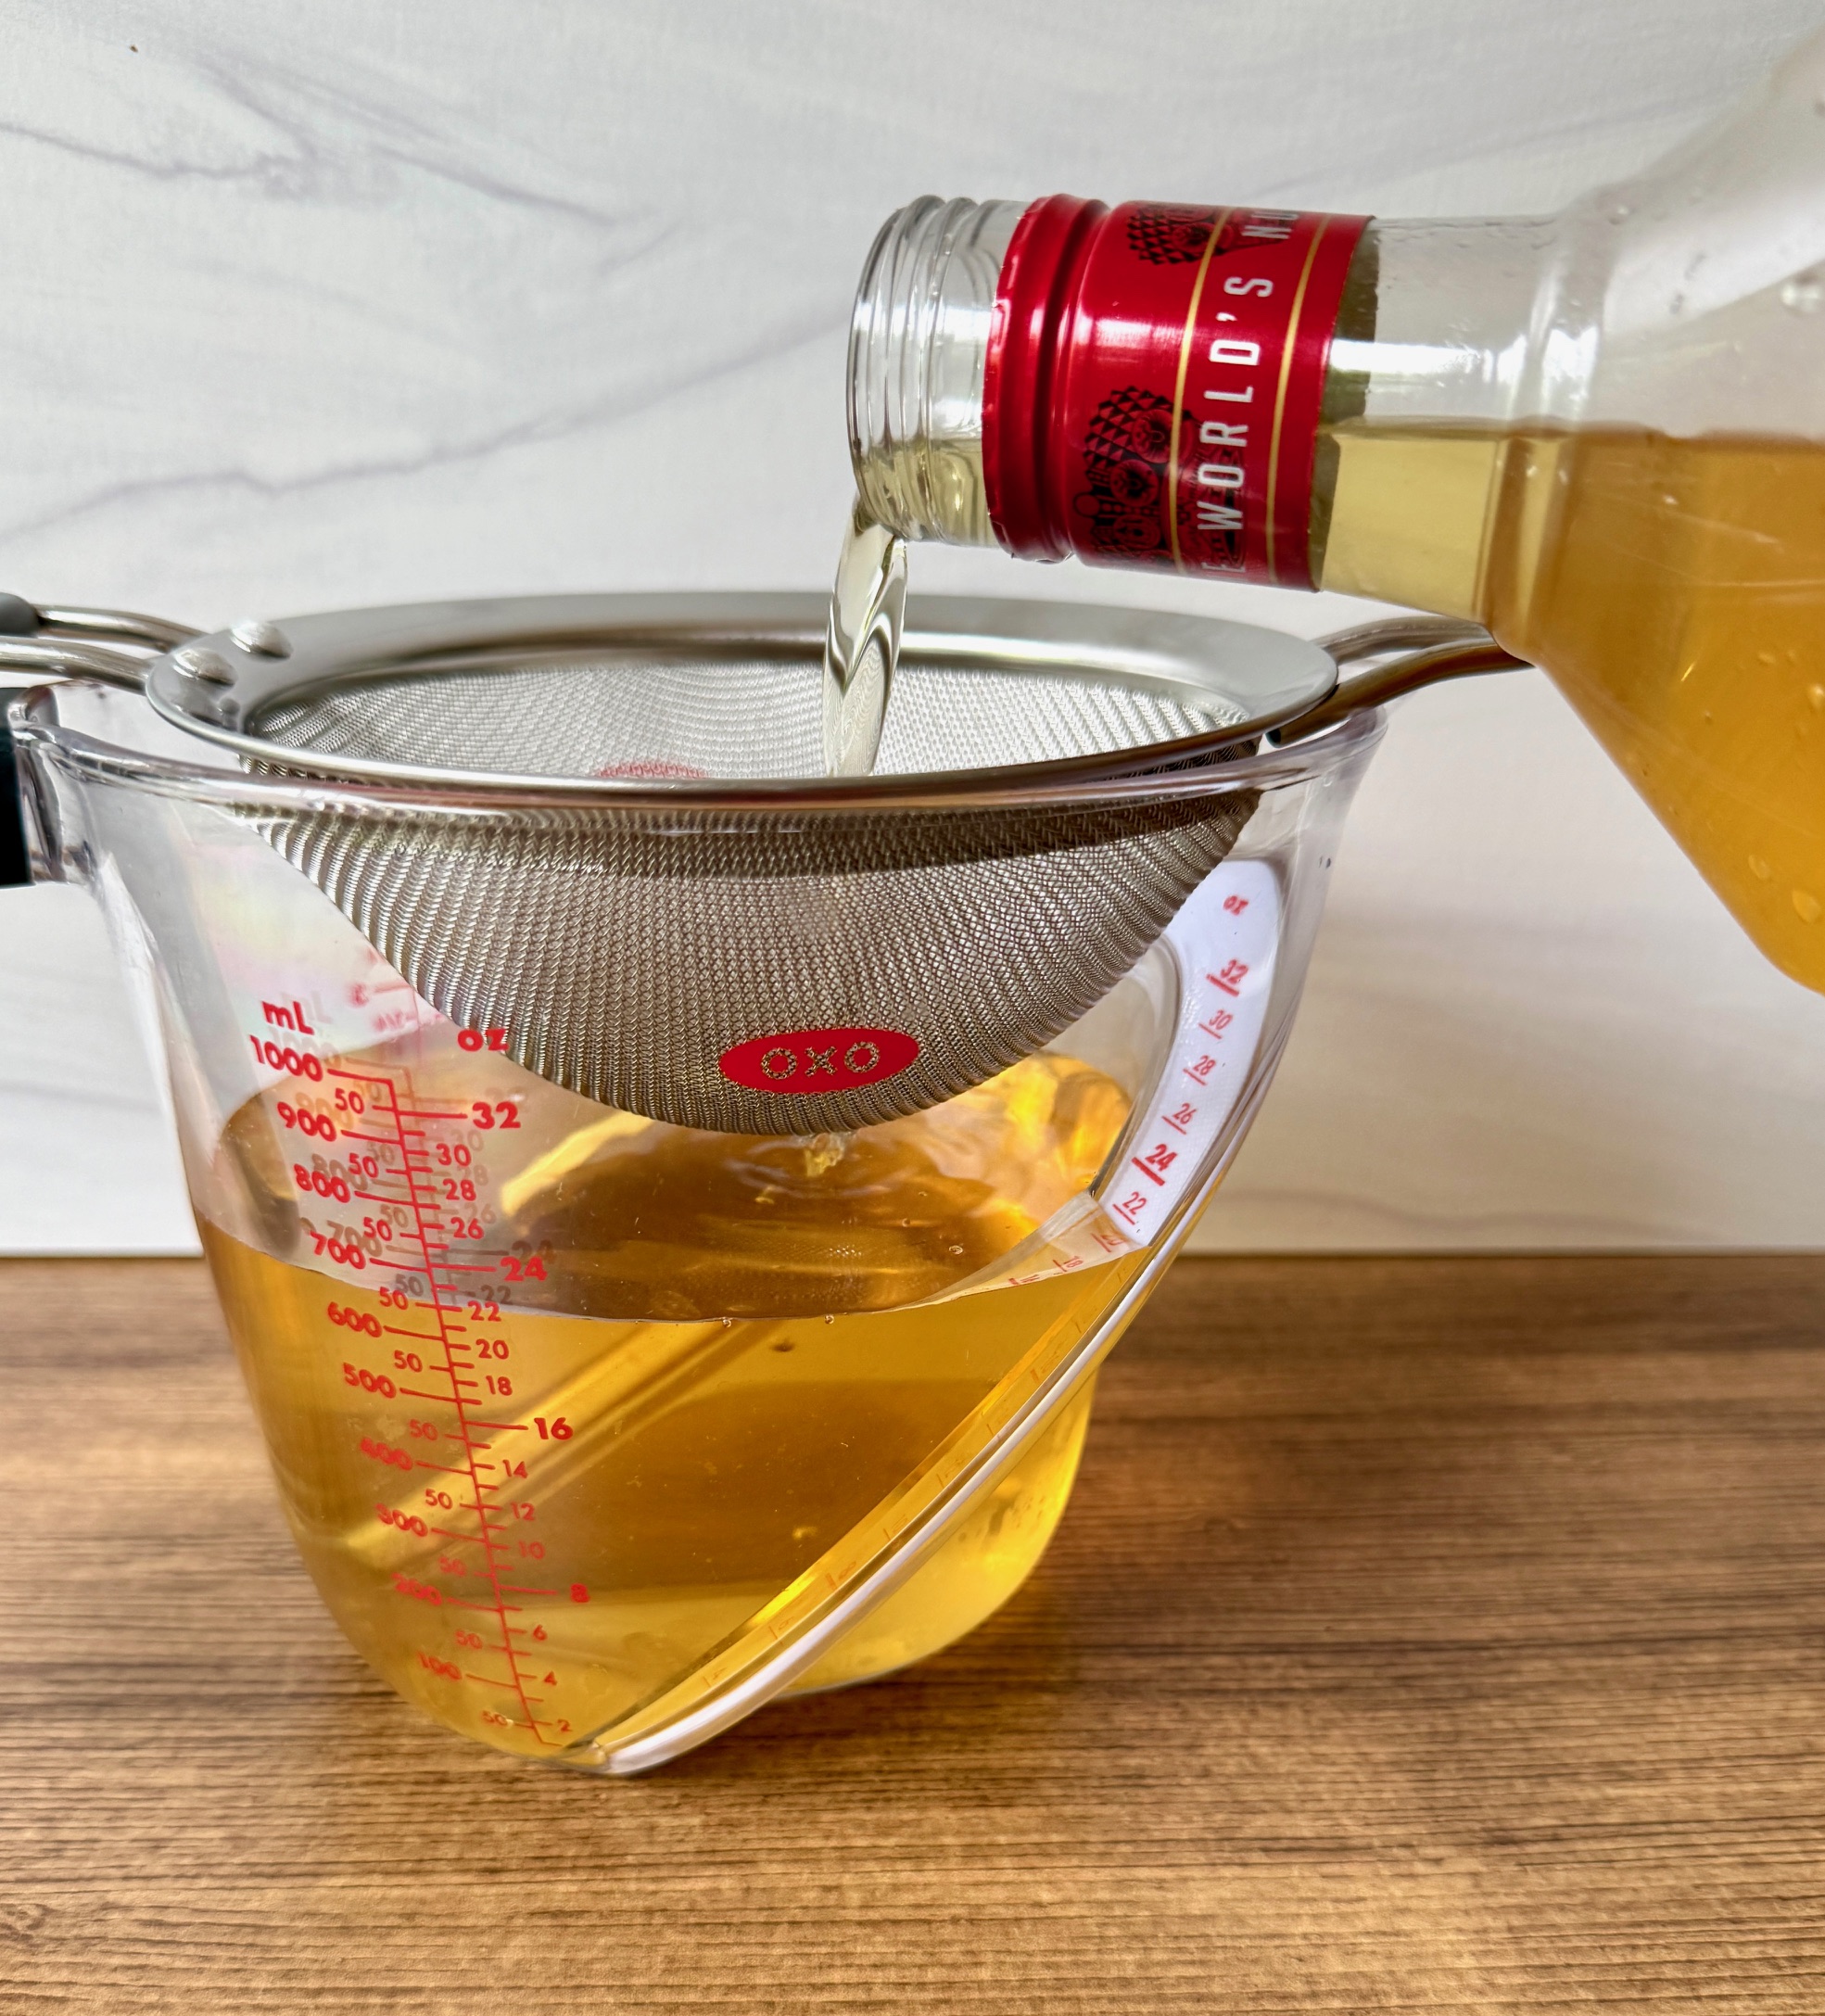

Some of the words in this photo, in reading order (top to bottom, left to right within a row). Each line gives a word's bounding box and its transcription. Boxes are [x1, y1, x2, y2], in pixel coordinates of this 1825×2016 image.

[1197, 276, 1274, 531] WORLD'S
[1220, 958, 1249, 984] 32
[262, 1001, 314, 1035] mL
[1208, 1008, 1233, 1031] 30
[457, 1028, 510, 1052] oz
[250, 1034, 323, 1082] 1000
[761, 1041, 881, 1080] OXO
[1193, 1055, 1217, 1076] 28
[335, 1088, 365, 1114] 50
[1172, 1102, 1198, 1124] 26
[277, 1102, 337, 1142] 900
[472, 1101, 521, 1129] 32
[349, 1152, 379, 1178] 50
[436, 1143, 473, 1167] 30
[1145, 1143, 1178, 1172] 24
[294, 1163, 351, 1203] 800
[443, 1178, 477, 1201] 28
[1122, 1191, 1147, 1215] 22
[363, 1216, 393, 1242] 50
[450, 1216, 485, 1240] 26
[310, 1231, 366, 1270] 700
[500, 1256, 548, 1282] 24
[378, 1287, 409, 1310] 50
[327, 1301, 383, 1338] 600
[467, 1300, 502, 1322] 22
[475, 1338, 509, 1360] 20
[394, 1350, 423, 1373] 50
[343, 1362, 397, 1399] 500
[485, 1376, 513, 1397] 18
[409, 1419, 438, 1441] 50
[534, 1416, 574, 1440] 16
[503, 1459, 528, 1479] 14
[425, 1488, 453, 1510] 50
[375, 1502, 428, 1537] 300
[510, 1502, 536, 1521] 12
[518, 1540, 545, 1560] 10
[570, 1583, 590, 1604] 8
[455, 1629, 483, 1650] 50
[533, 1624, 548, 1642] 6
[543, 1671, 558, 1686] 4
[557, 1718, 573, 1732] 2
